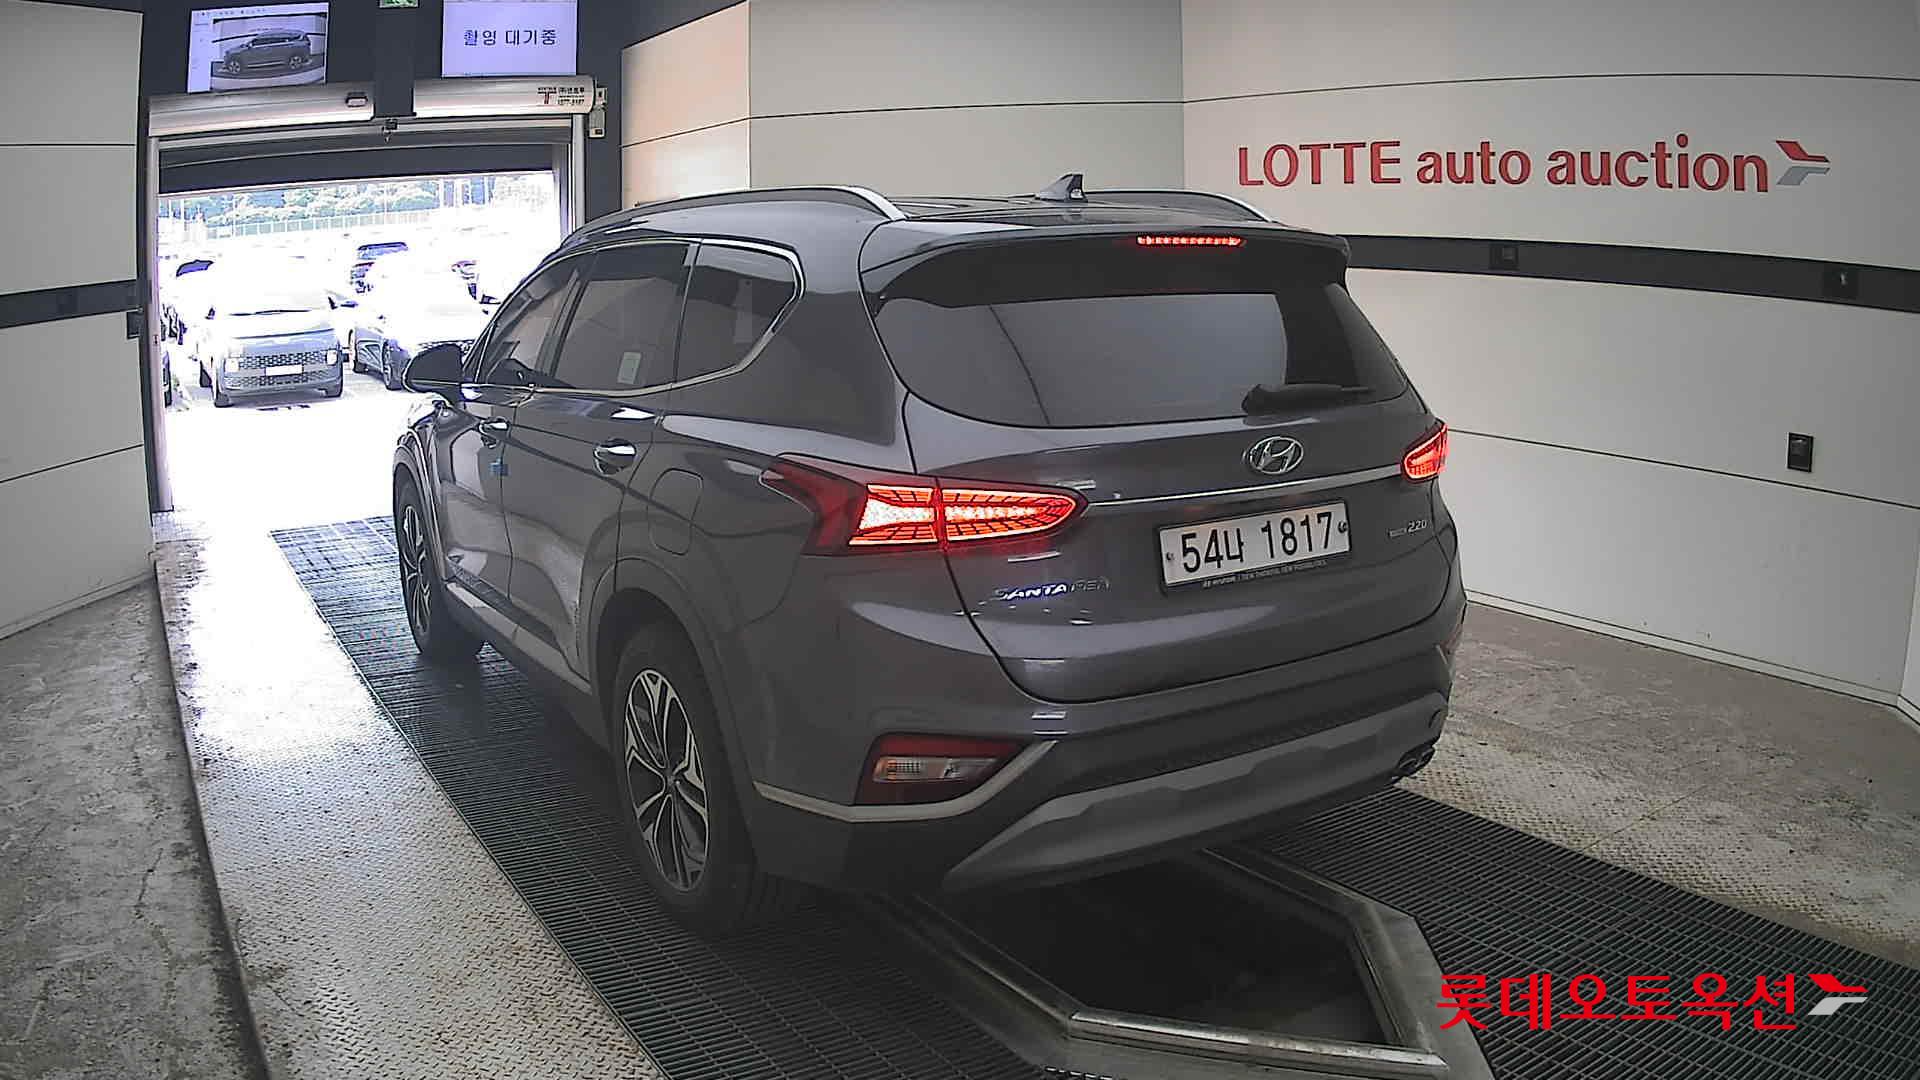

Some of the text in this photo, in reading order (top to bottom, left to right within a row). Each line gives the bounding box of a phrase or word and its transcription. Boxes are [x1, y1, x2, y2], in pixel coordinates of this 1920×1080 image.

[505, 29, 557, 46] 대기중
[1238, 134, 1769, 193] LOTTE auto auction
[1181, 511, 1333, 573] 54나 1817
